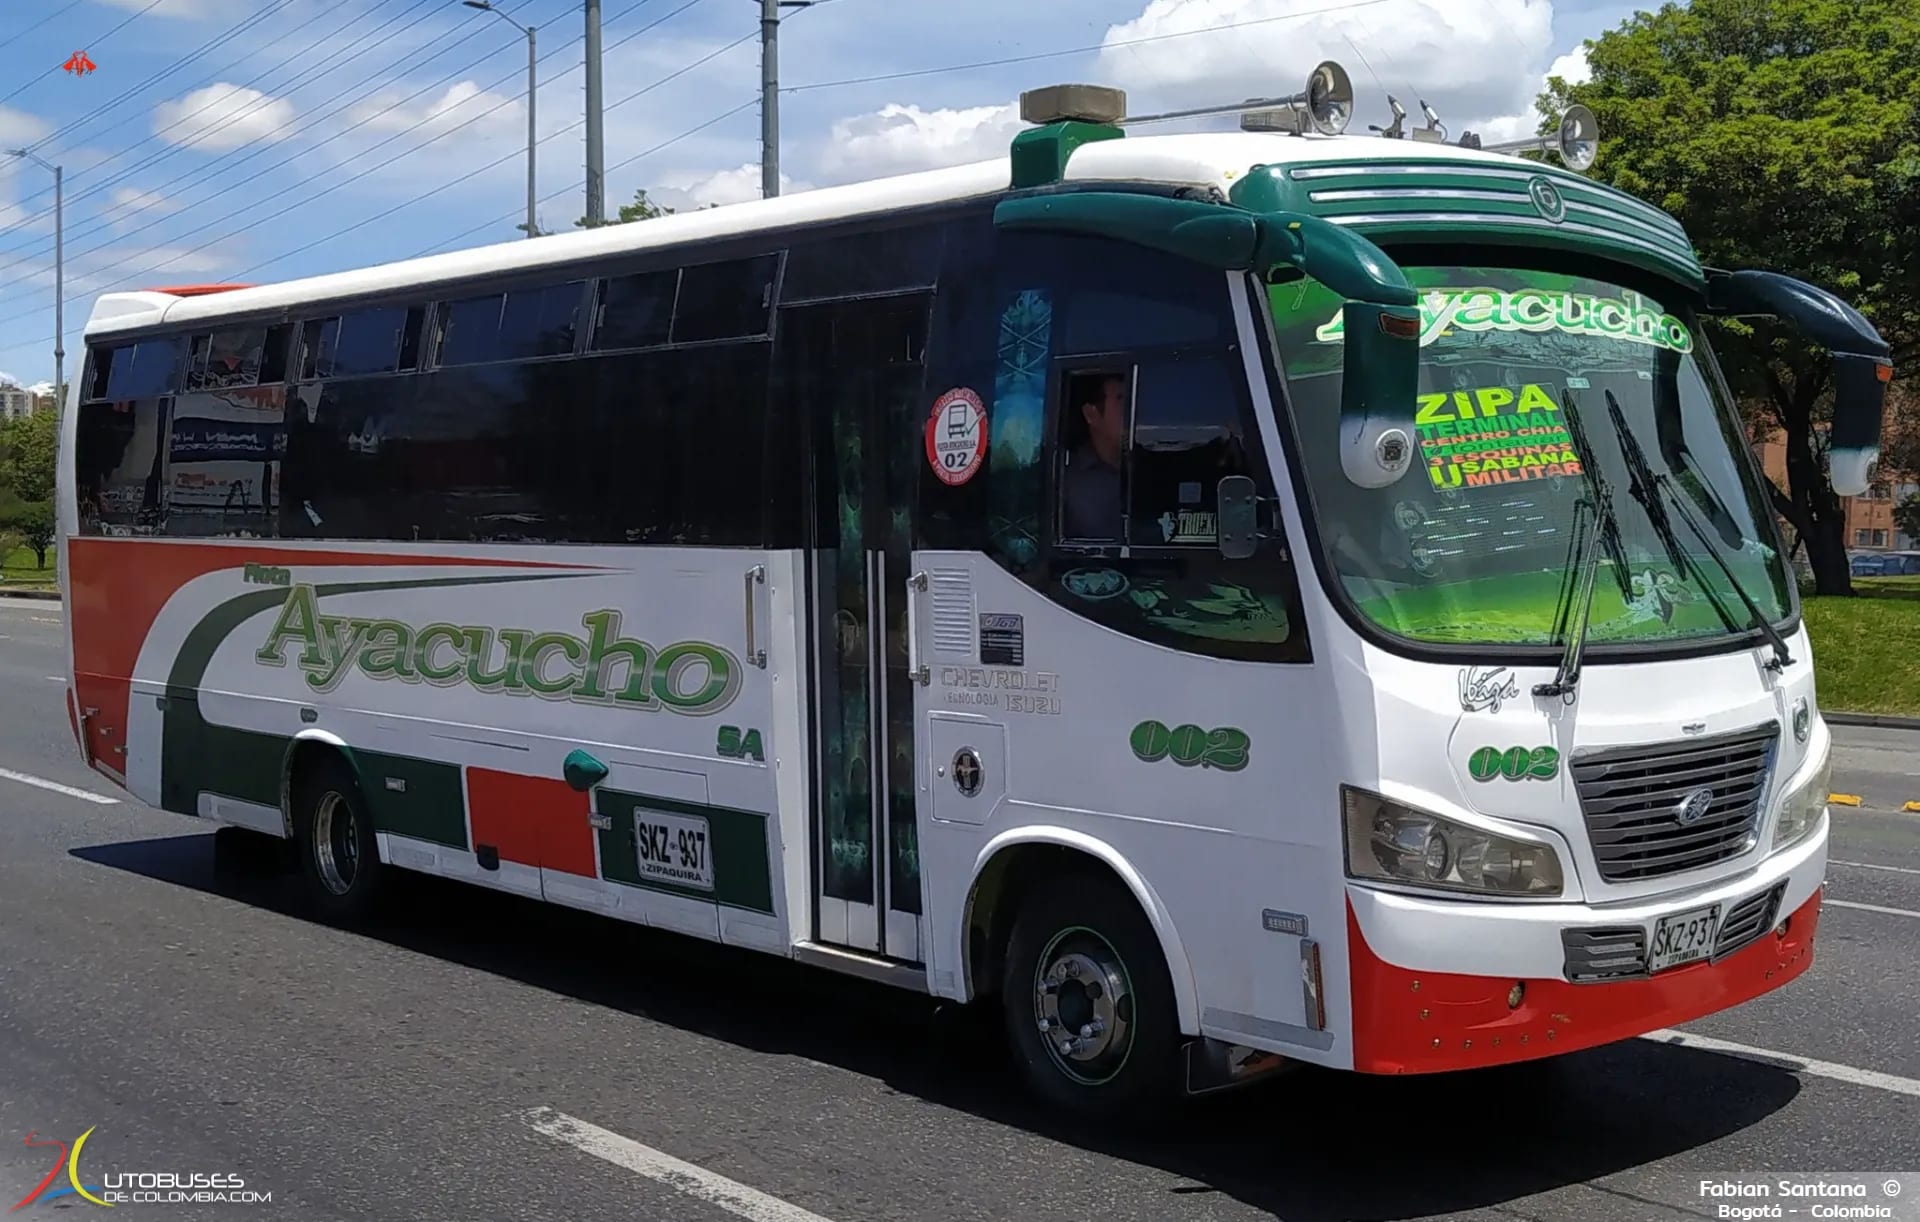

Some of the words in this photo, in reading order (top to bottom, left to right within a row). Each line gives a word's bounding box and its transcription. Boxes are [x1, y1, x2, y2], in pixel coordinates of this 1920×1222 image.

[1317, 287, 1692, 354] yacucho
[1415, 383, 1559, 425] ZIPA
[1415, 411, 1564, 440] TERMINAL
[1420, 431, 1510, 447] CENTRO
[1517, 426, 1567, 437] CHIA
[944, 452, 968, 468] 02
[1429, 457, 1444, 466] 3
[1451, 443, 1572, 463] ESQUINAS
[1430, 463, 1463, 489] U
[1461, 451, 1580, 474] SABANA
[1465, 462, 1584, 487] MILITAR
[256, 583, 743, 716] Ayacucho
[941, 667, 1060, 692] CHEVROLET
[1458, 665, 1521, 714] Ibiza
[1005, 694, 1061, 715] ISUZU
[716, 725, 765, 762] SA
[1129, 719, 1251, 772] 002
[1468, 745, 1560, 783] 002
[645, 864, 703, 882] ZIPAQUIRA
